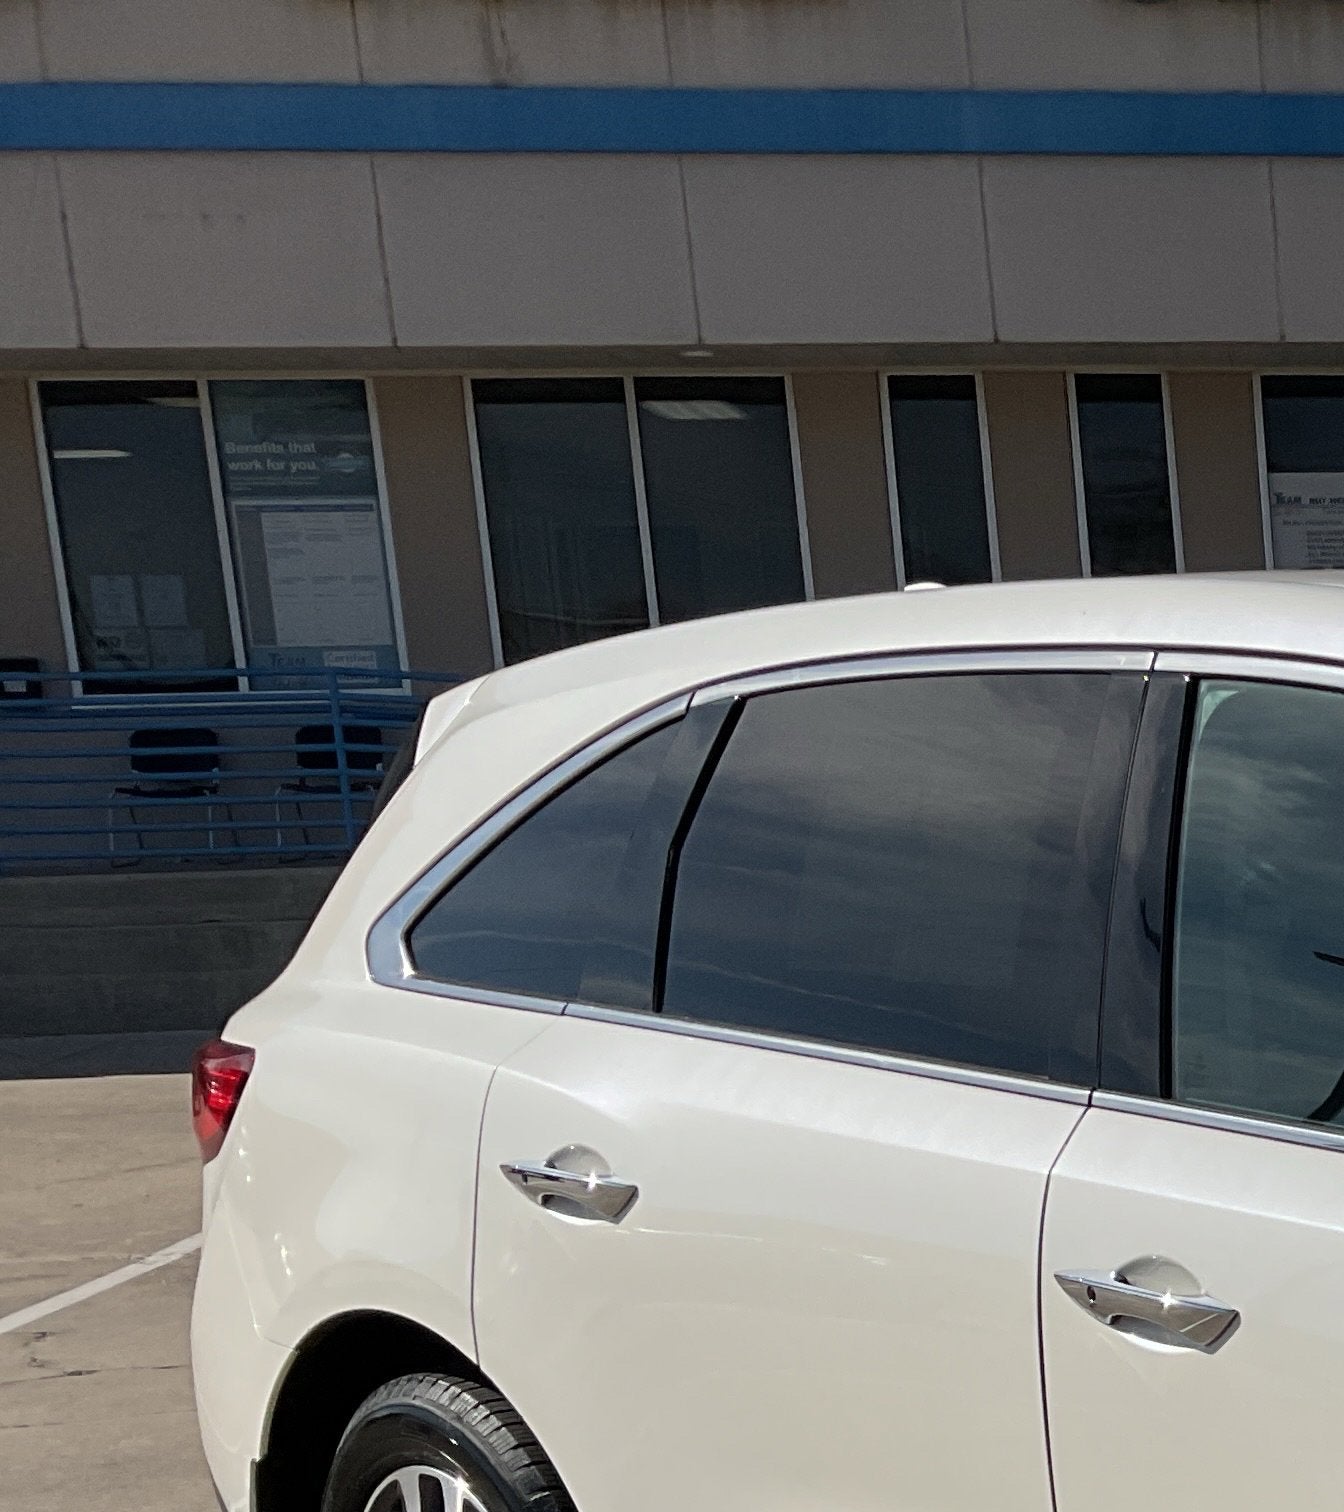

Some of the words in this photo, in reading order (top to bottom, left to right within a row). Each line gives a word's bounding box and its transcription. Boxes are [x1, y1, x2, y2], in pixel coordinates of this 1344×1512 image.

[224, 442, 284, 454] Benefits
[288, 442, 317, 454] that
[227, 460, 263, 472] work
[266, 459, 285, 471] for
